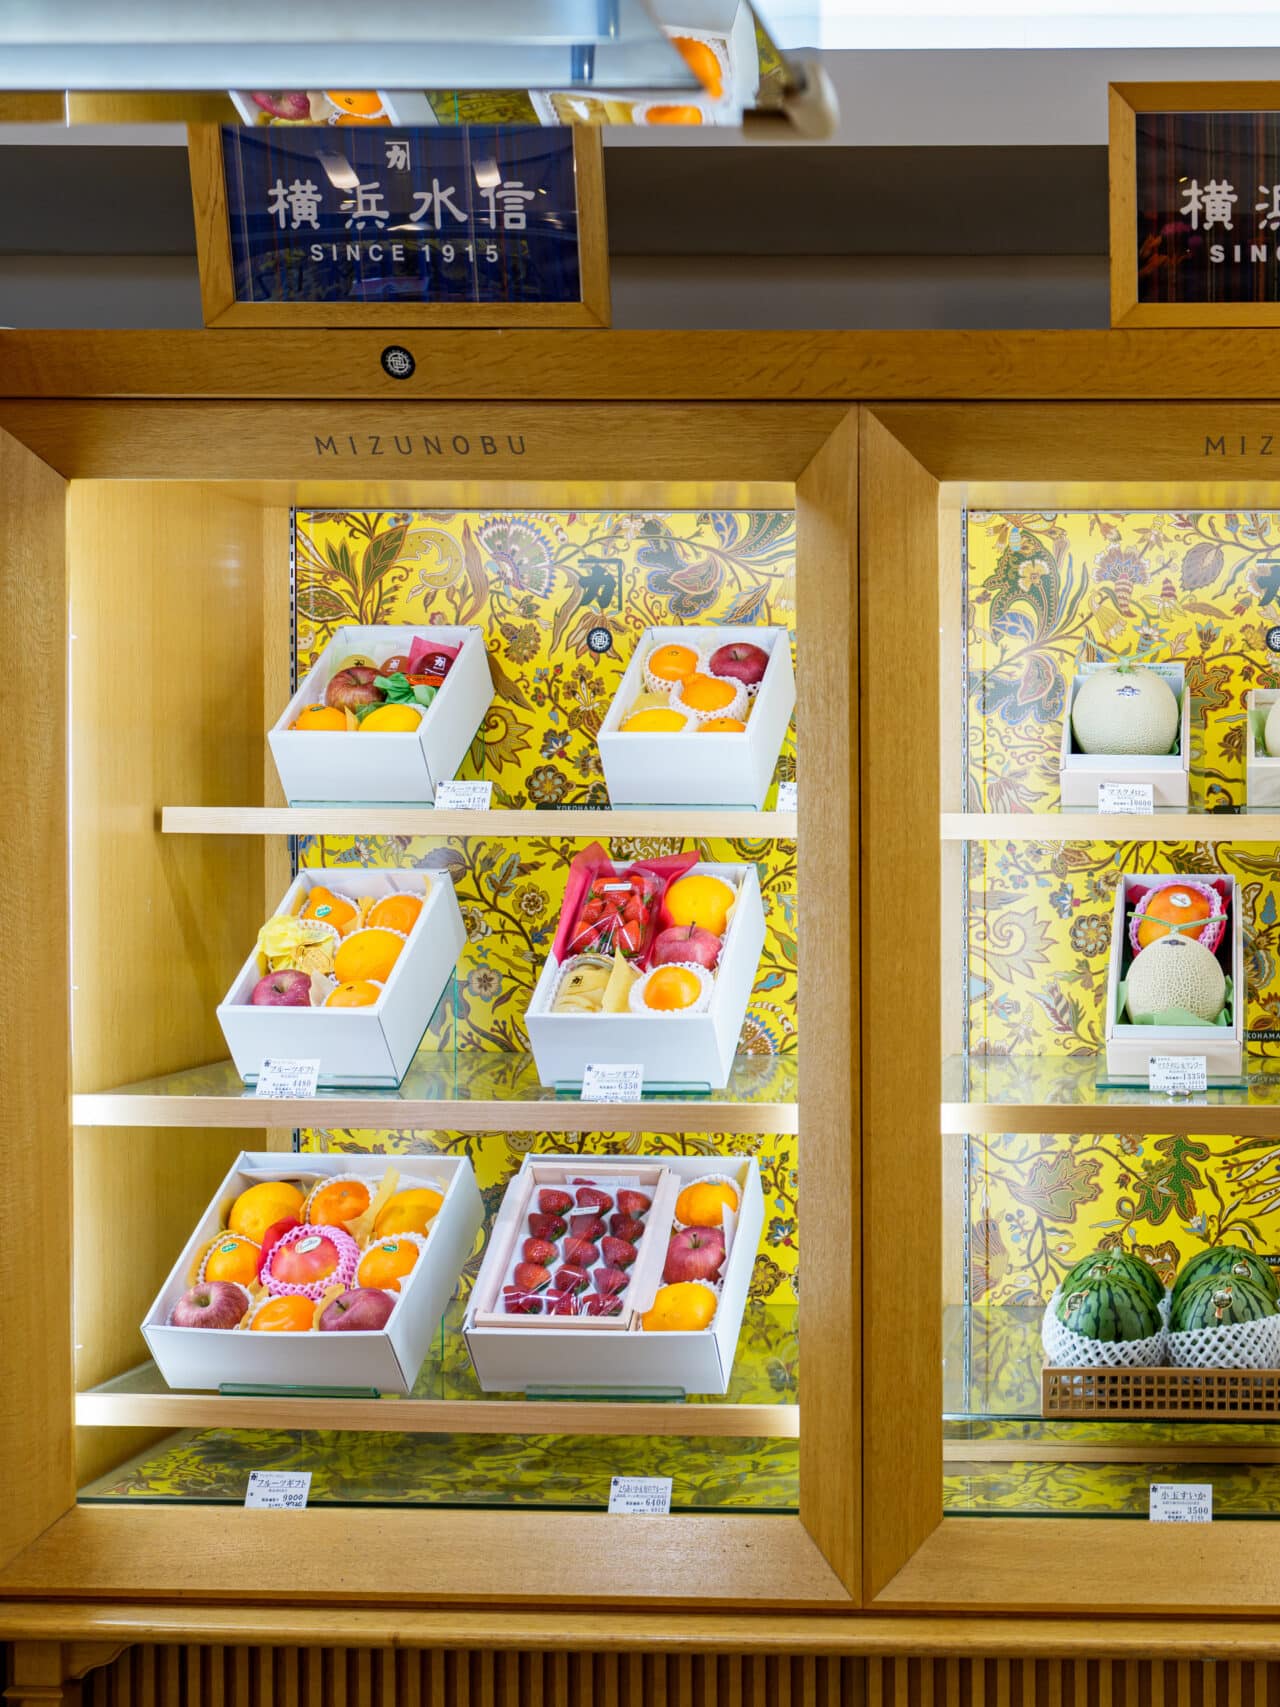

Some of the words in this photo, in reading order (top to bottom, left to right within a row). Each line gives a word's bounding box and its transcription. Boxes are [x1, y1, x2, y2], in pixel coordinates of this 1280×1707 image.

[267, 178, 536, 231] 横浜水信
[310, 244, 405, 262] SINCE
[421, 244, 499, 263] 1915
[315, 435, 528, 457] MIZUNOBU
[256, 1479, 307, 1489] フルーツギフト
[1160, 1491, 1207, 1501] 小玉すいか
[645, 1498, 666, 1507] 6400
[1187, 1506, 1209, 1515] 3500
